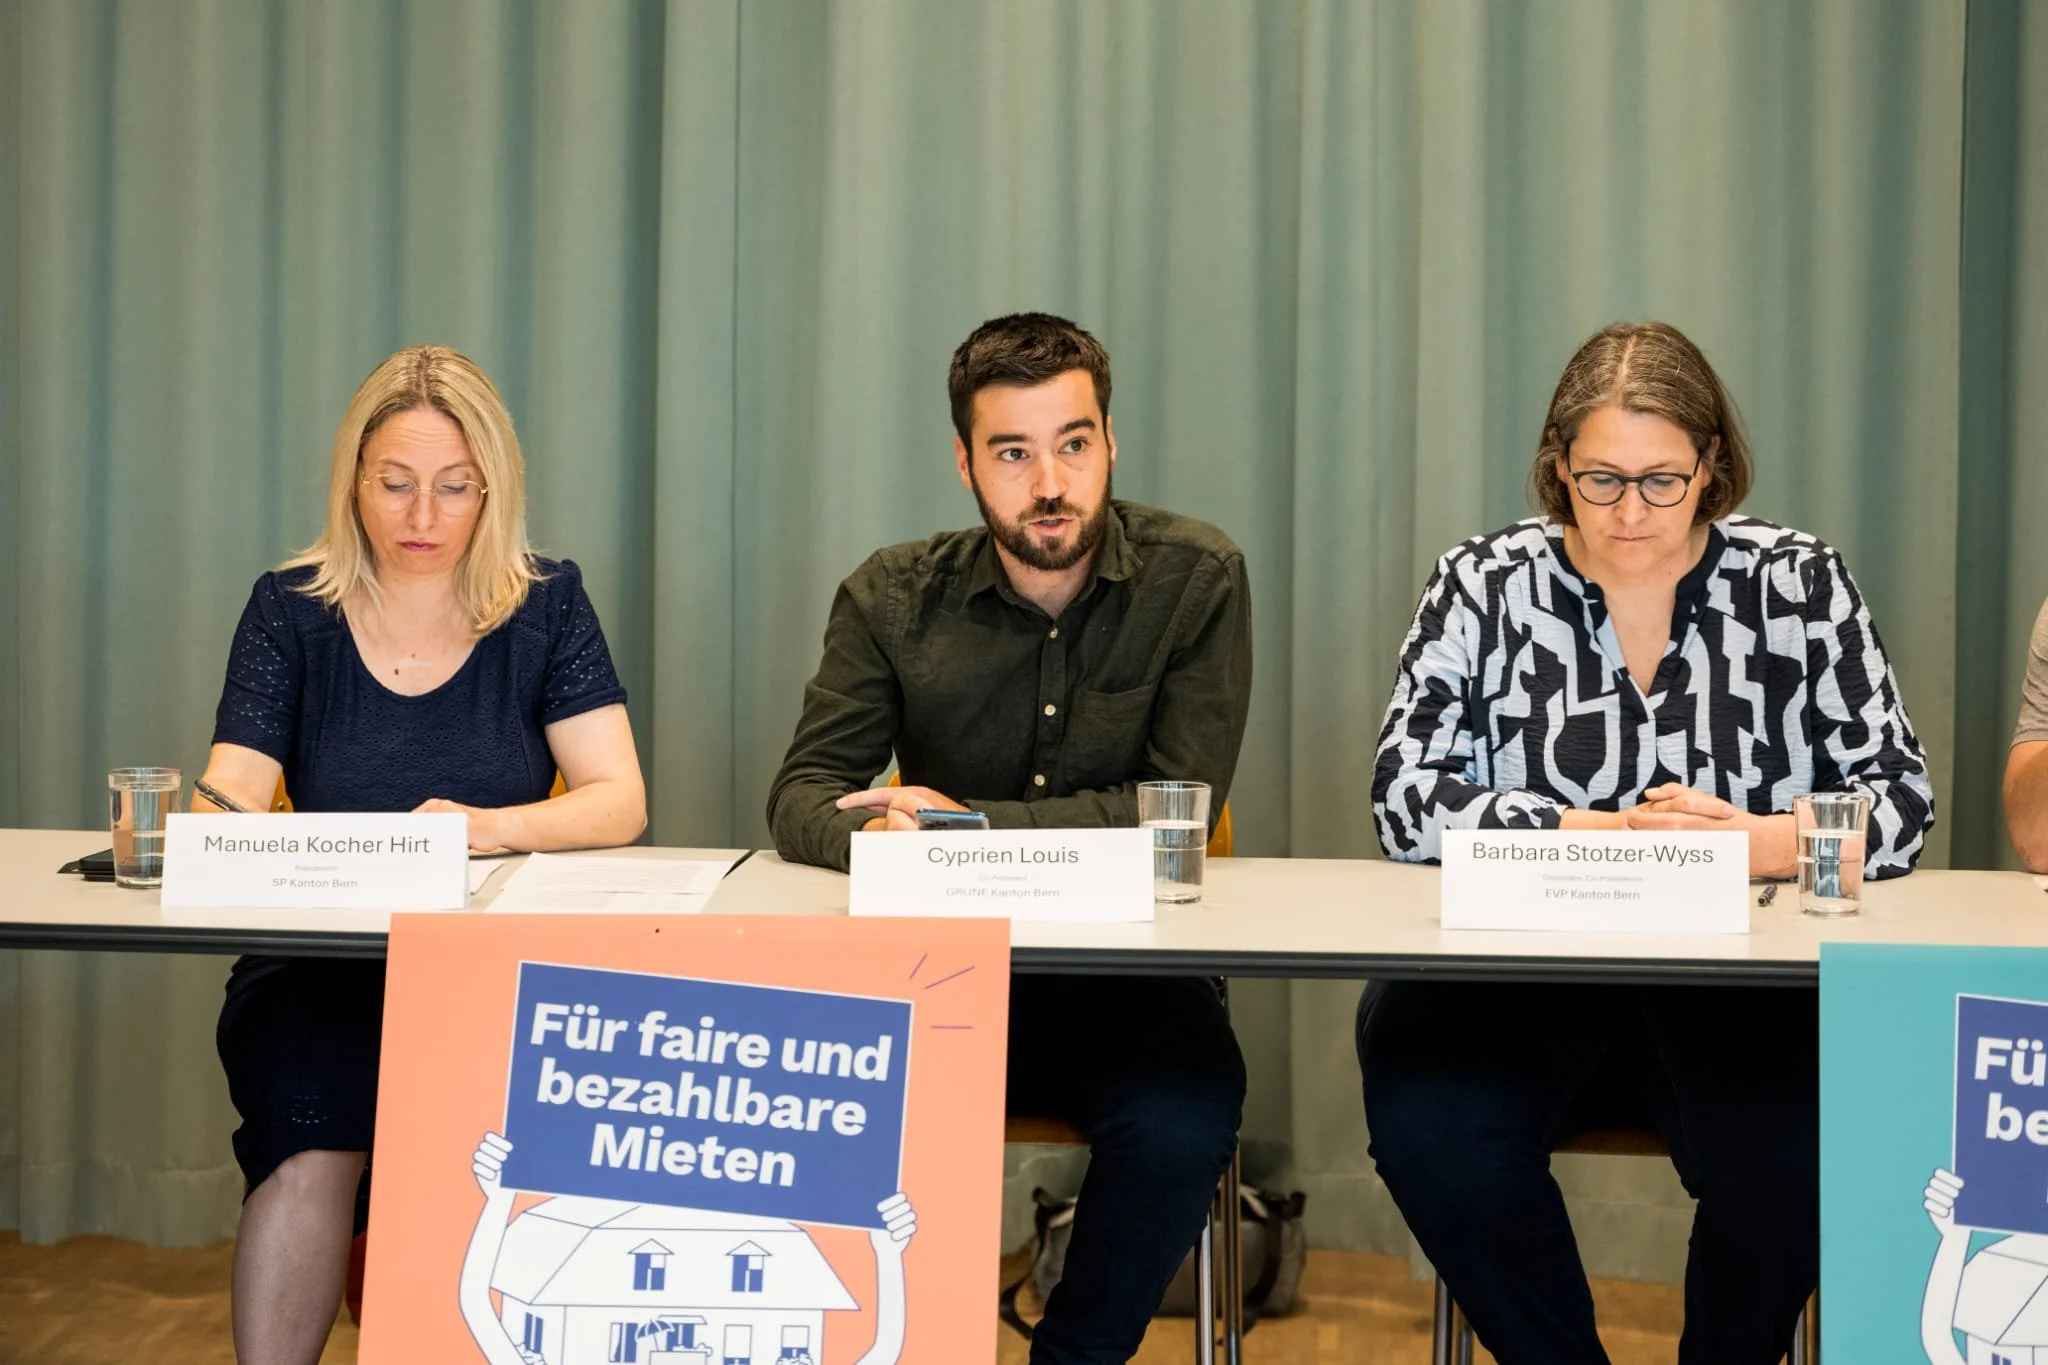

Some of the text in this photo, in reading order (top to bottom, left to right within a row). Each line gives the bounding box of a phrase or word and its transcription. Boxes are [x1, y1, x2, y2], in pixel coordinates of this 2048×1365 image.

[204, 835, 431, 855] Manuela Kocher Hirt
[1472, 841, 1715, 868] Barbara Stotzer-Wyss
[927, 846, 1080, 868] Cyprien Louis
[271, 877, 359, 889] SP Kanton Bern
[990, 888, 1031, 898] Kanton
[1033, 888, 1060, 898] Bern
[1545, 888, 1641, 901] EVP Kanton Bern
[530, 1002, 893, 1082] Für faire und
[536, 1056, 867, 1136] bezahlbare
[589, 1122, 796, 1187] Mieten
